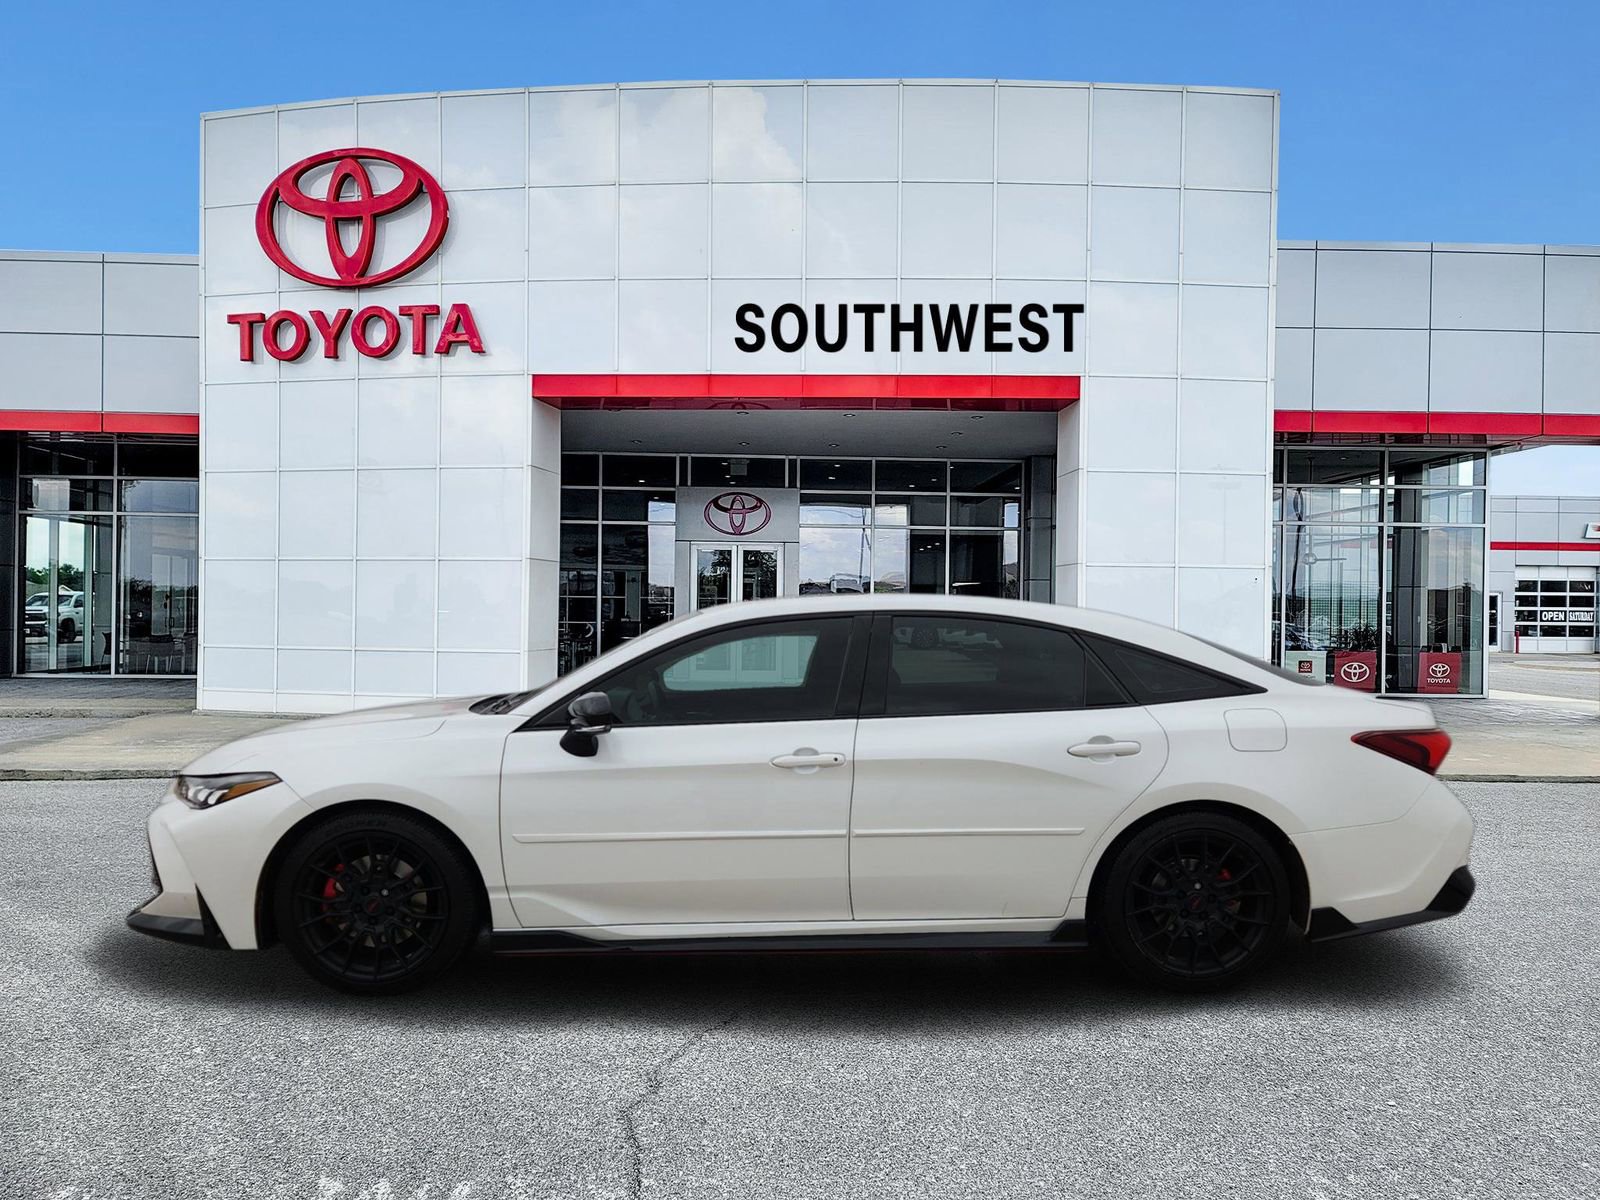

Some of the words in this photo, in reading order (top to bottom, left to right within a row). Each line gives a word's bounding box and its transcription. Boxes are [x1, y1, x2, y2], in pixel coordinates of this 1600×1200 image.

[227, 303, 485, 361] TOYOTA
[735, 303, 1084, 352] SOUTHWEST
[1542, 611, 1565, 621] OPEN
